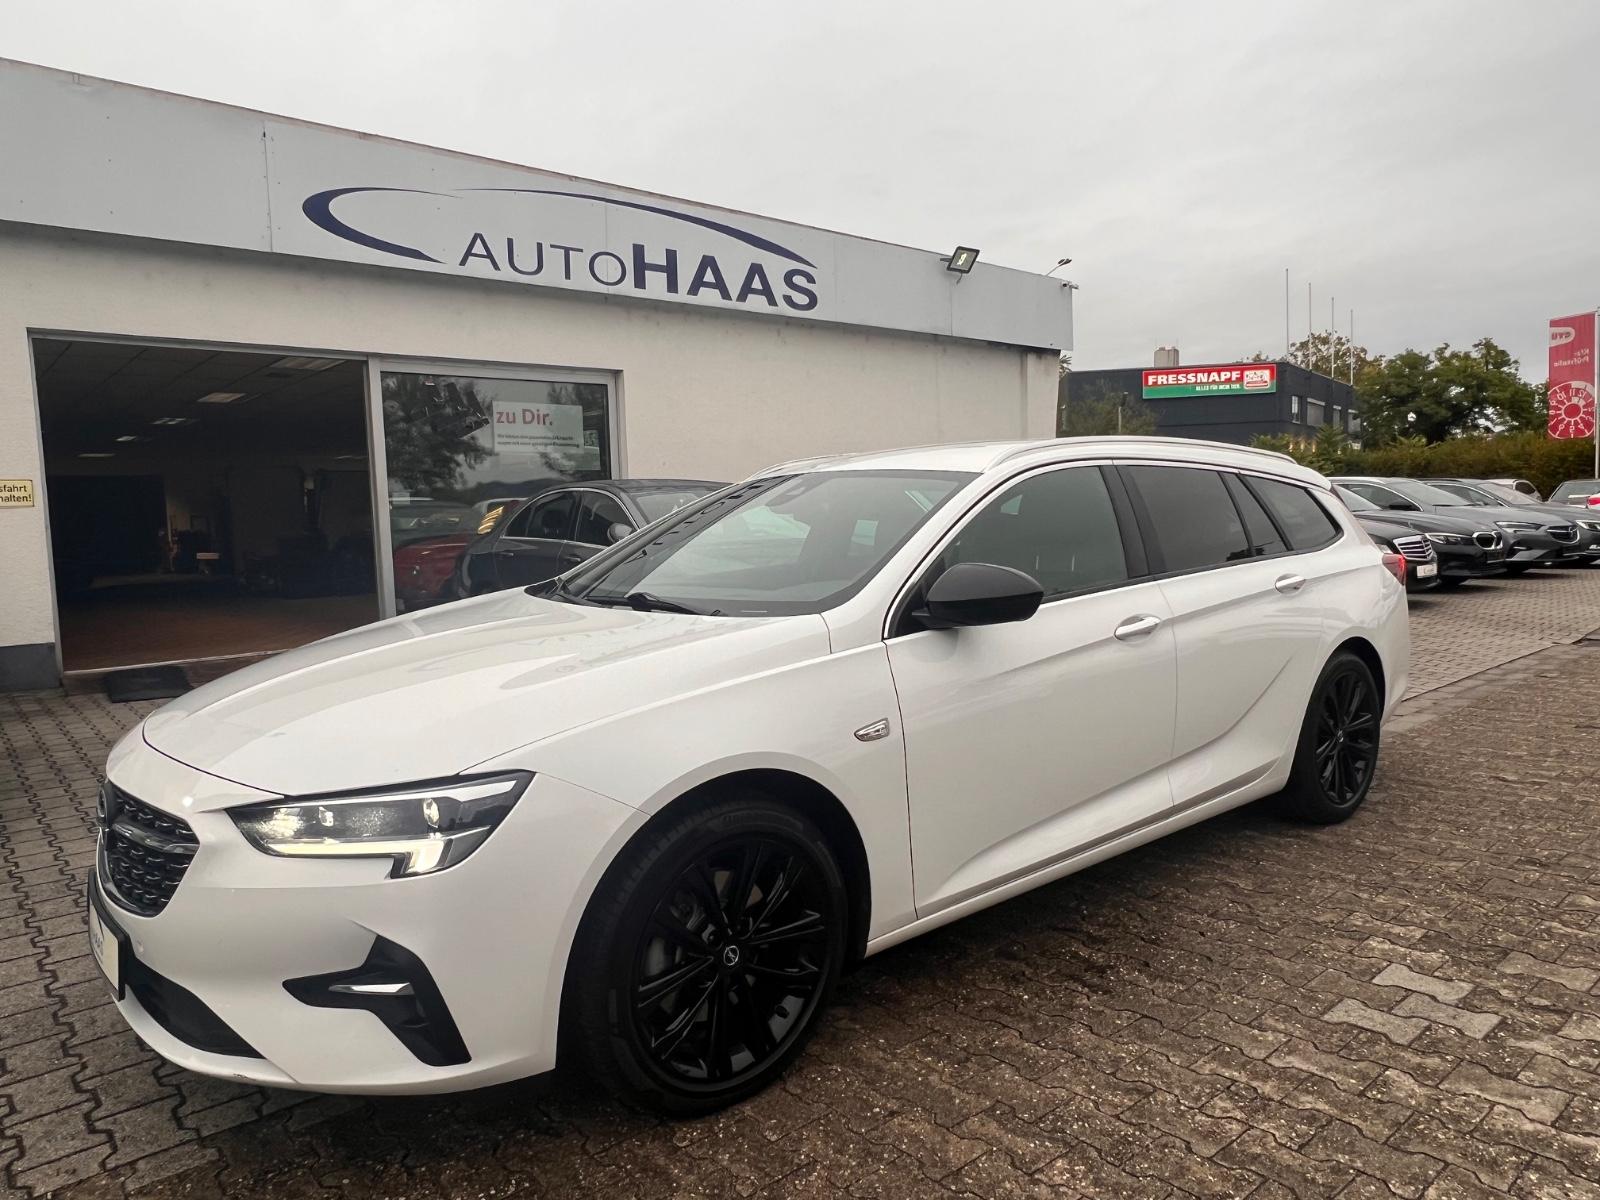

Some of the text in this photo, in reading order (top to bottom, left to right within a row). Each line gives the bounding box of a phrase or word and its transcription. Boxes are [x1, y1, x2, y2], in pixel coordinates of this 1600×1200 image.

[1147, 371, 1241, 386] FRESSNAPF
[496, 408, 553, 426] zu Dir.
